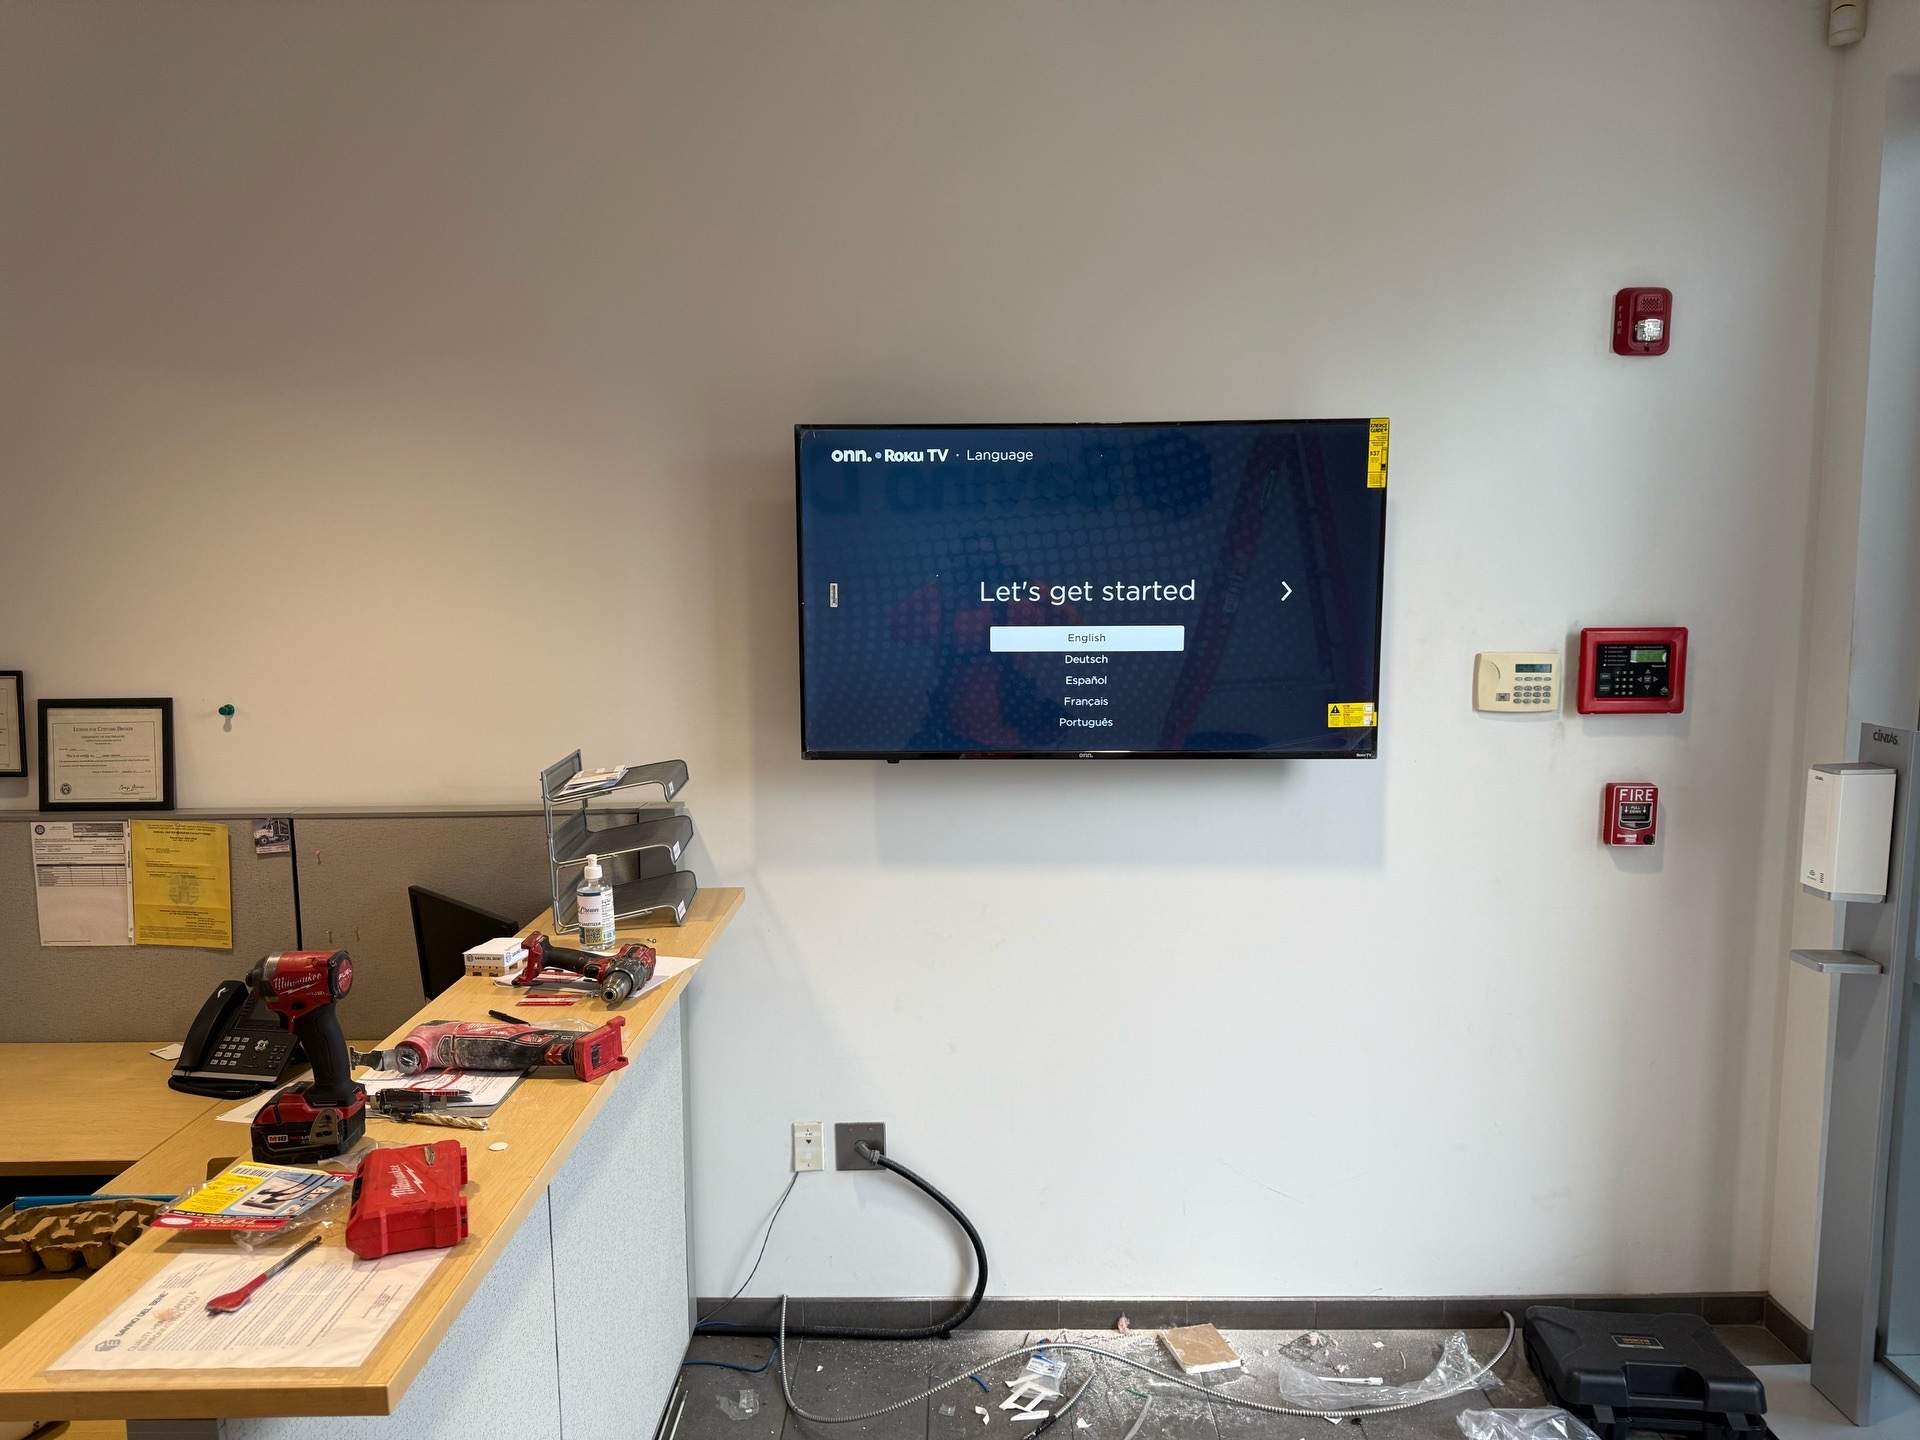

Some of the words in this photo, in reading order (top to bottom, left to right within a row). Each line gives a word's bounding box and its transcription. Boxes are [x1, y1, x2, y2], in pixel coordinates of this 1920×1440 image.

[831, 449, 872, 463] onn.
[927, 448, 949, 462] TV
[967, 449, 1034, 463] Language
[980, 581, 1040, 602] Let's
[1050, 581, 1093, 605] get
[1102, 579, 1195, 601] started
[1068, 633, 1106, 643] English
[1065, 655, 1108, 664] Deutsch
[1066, 676, 1107, 686] Español
[1064, 697, 1109, 706] Français
[1059, 717, 1113, 728] Português
[1619, 789, 1653, 801] FIRE
[387, 1165, 417, 1198] Milwaukee
